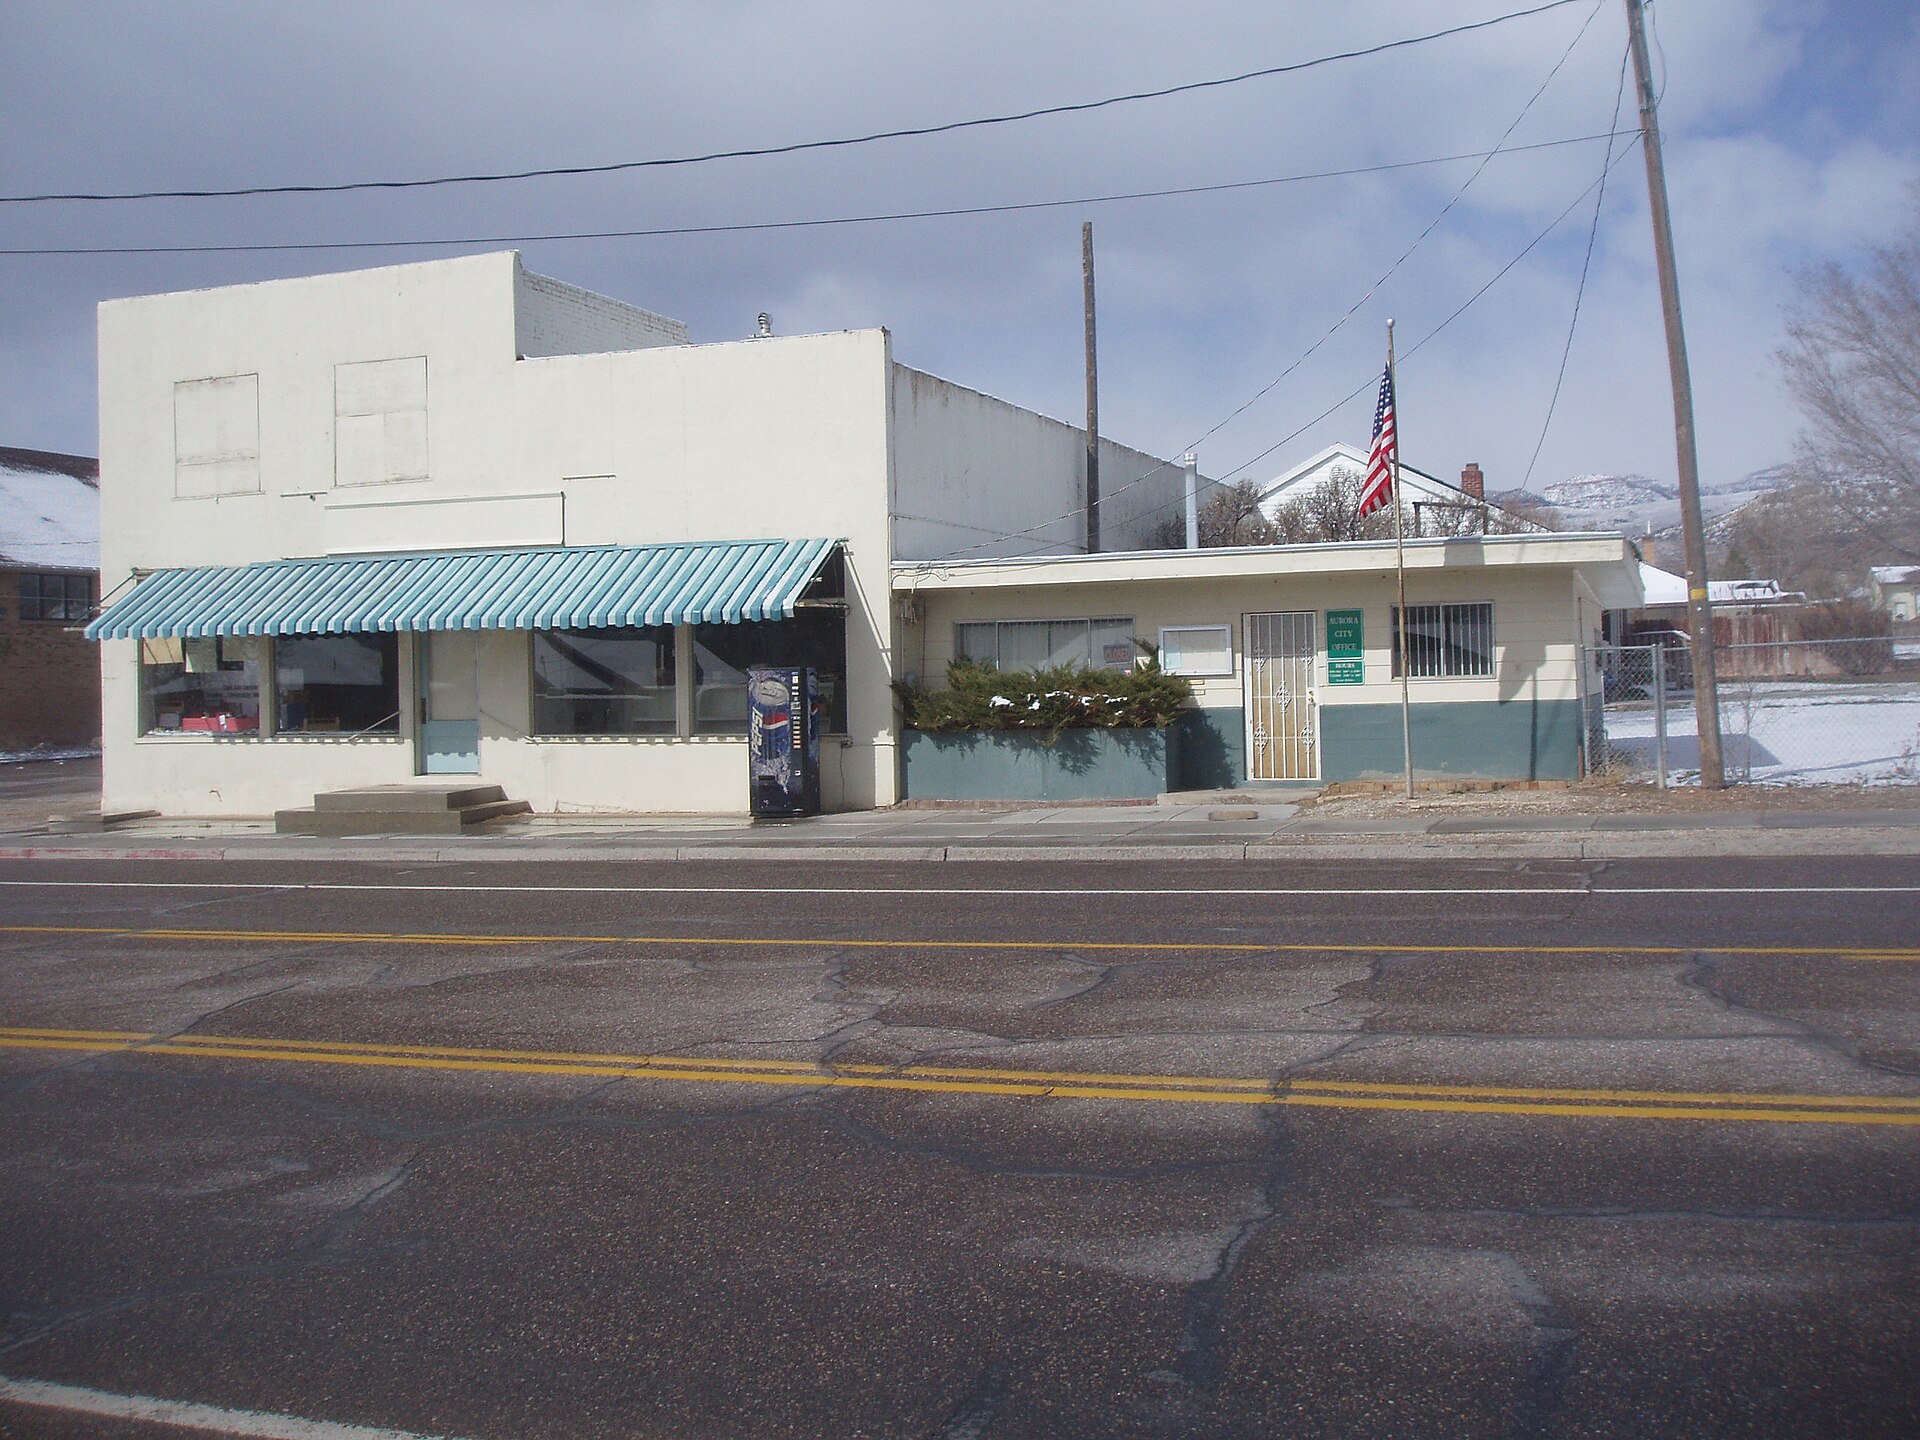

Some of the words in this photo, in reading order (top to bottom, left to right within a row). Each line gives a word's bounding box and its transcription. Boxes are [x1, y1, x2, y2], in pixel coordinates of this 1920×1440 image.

[1329, 616, 1359, 625] AURORA
[1334, 630, 1353, 638] CITY
[1331, 643, 1357, 651] OFFICE
[752, 706, 764, 755] PEPSI
